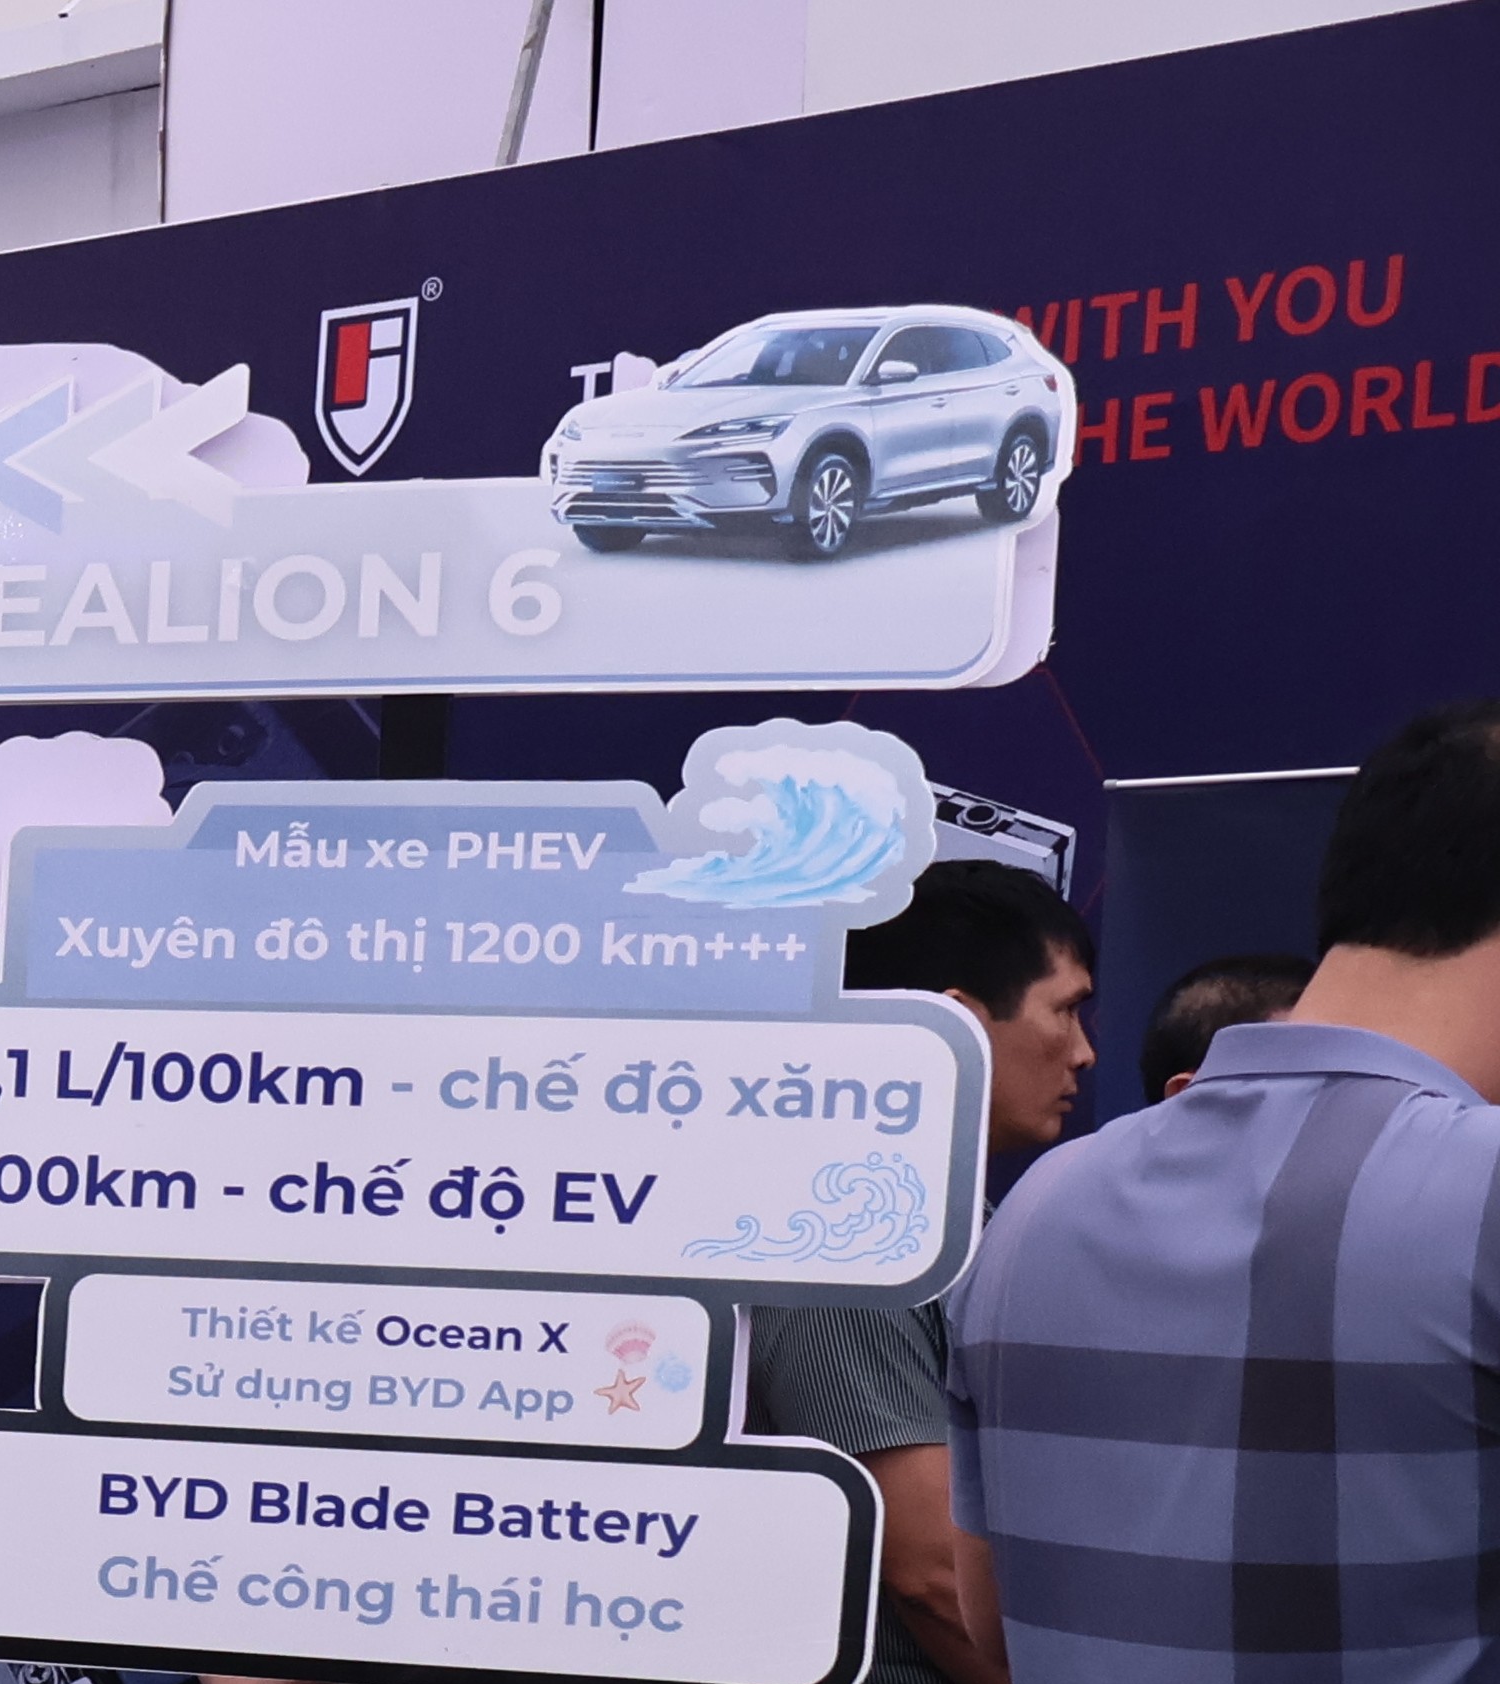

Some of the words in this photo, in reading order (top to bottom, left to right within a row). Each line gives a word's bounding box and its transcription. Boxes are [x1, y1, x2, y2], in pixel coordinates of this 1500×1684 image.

[1225, 254, 1405, 342] YOU
[1073, 392, 1175, 468] HE
[489, 549, 563, 636] 6
[235, 823, 349, 871] Mẫu
[365, 834, 430, 870] xe
[446, 831, 607, 873] PHEV
[55, 915, 237, 973] Xuyên
[255, 917, 330, 961] đô
[347, 917, 427, 972] thị
[446, 922, 581, 966] 1200
[600, 920, 807, 968] km+++
[268, 1158, 412, 1218] chế
[428, 1166, 526, 1235] độ
[552, 1173, 659, 1225] EV
[182, 1306, 292, 1343] Thiết
[308, 1308, 366, 1344] kế
[375, 1315, 522, 1352] Ocean
[536, 1319, 571, 1354] X
